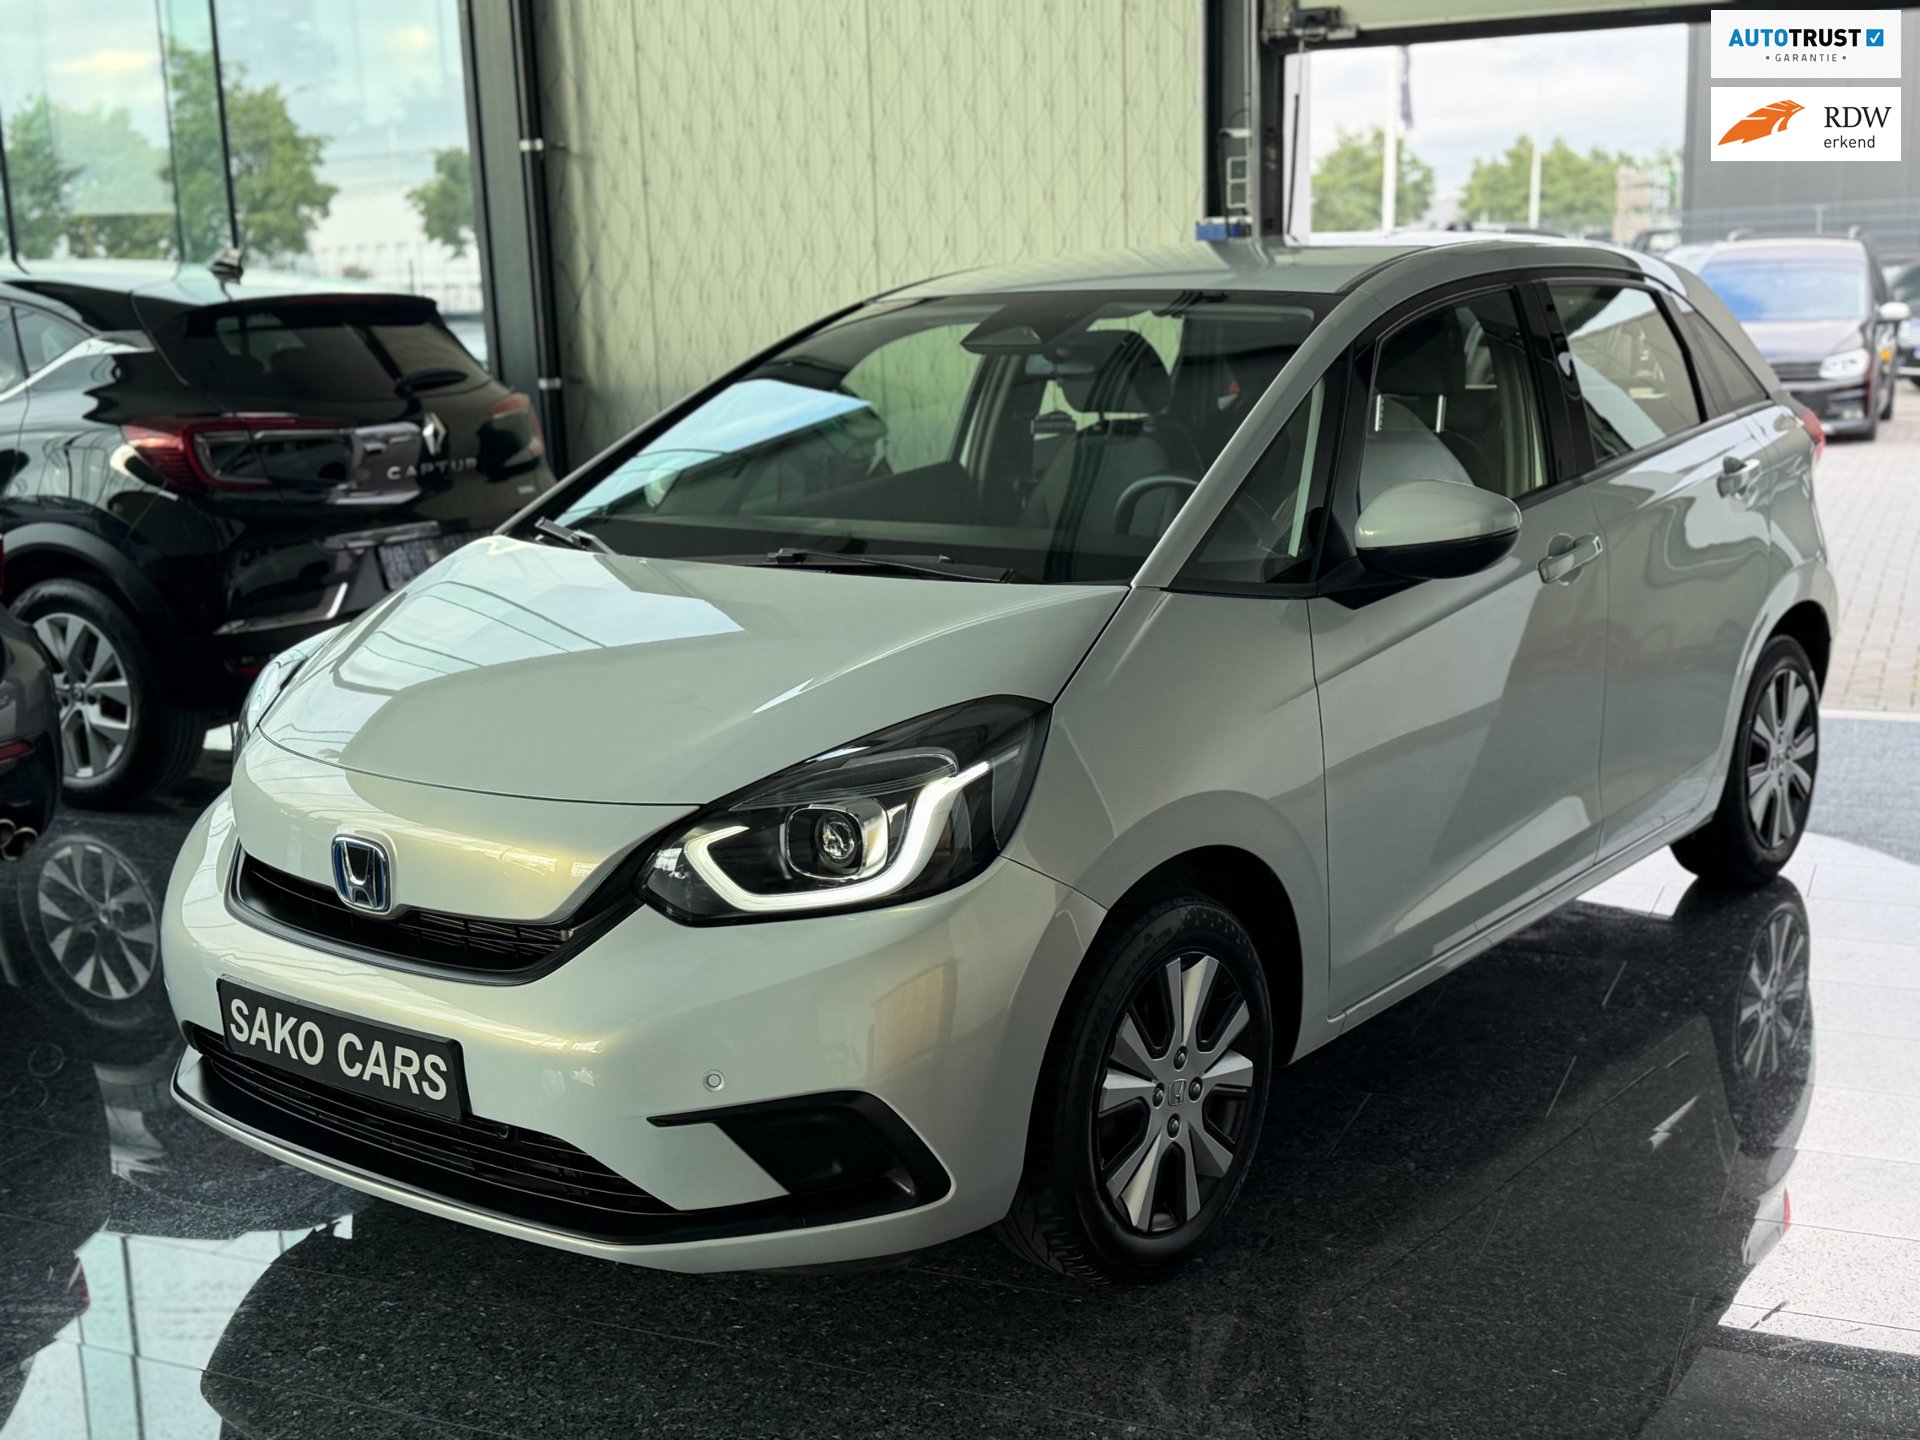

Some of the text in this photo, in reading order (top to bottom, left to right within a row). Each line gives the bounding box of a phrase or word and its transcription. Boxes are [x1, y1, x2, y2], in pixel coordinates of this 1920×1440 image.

[386, 457, 478, 480] CAPTUR
[229, 998, 448, 1101] SAKO CARS
